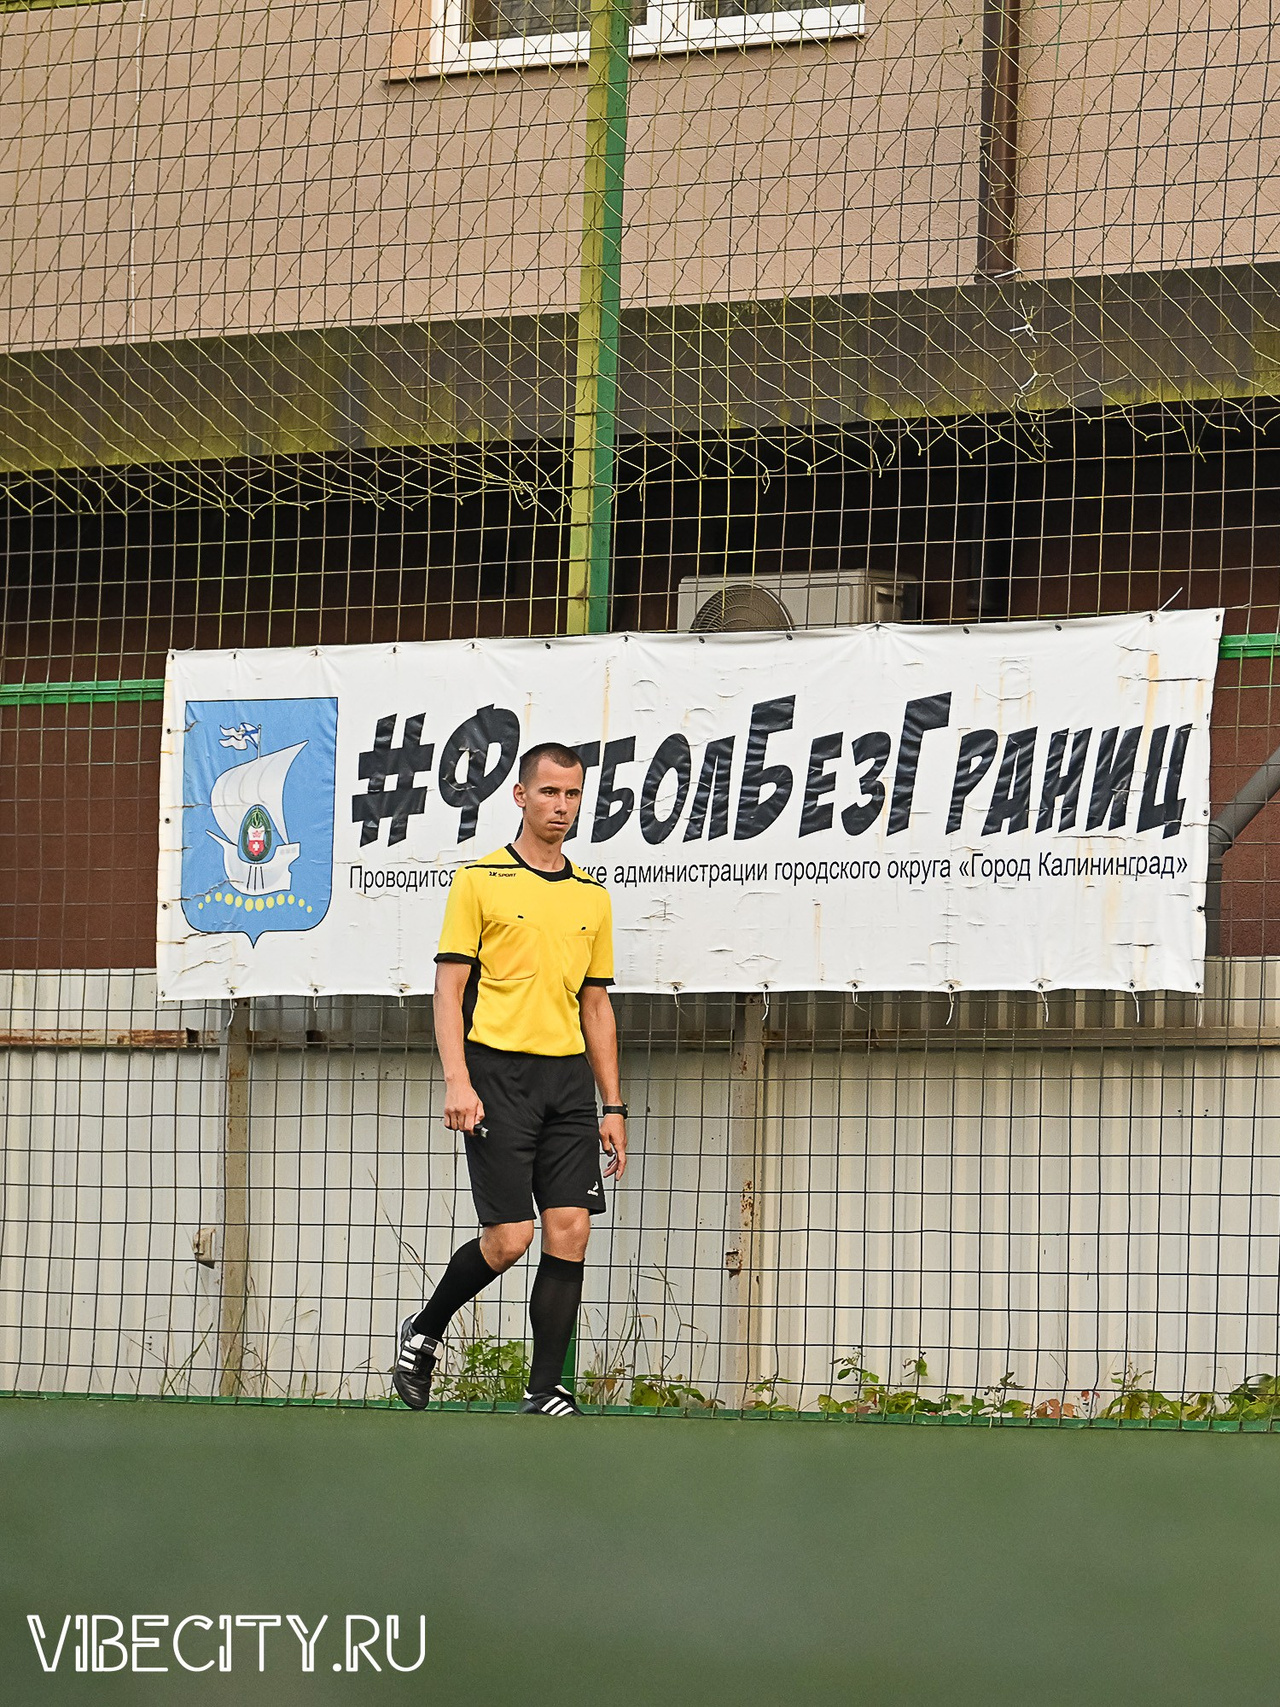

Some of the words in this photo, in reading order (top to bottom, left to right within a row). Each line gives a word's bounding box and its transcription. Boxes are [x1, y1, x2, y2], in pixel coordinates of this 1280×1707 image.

[350, 865, 457, 889] Проводится
[614, 863, 768, 886] администрации
[774, 860, 881, 885] городского
[887, 859, 951, 884] округа
[959, 853, 1031, 883] «Город
[1038, 851, 1189, 882] Калининград»
